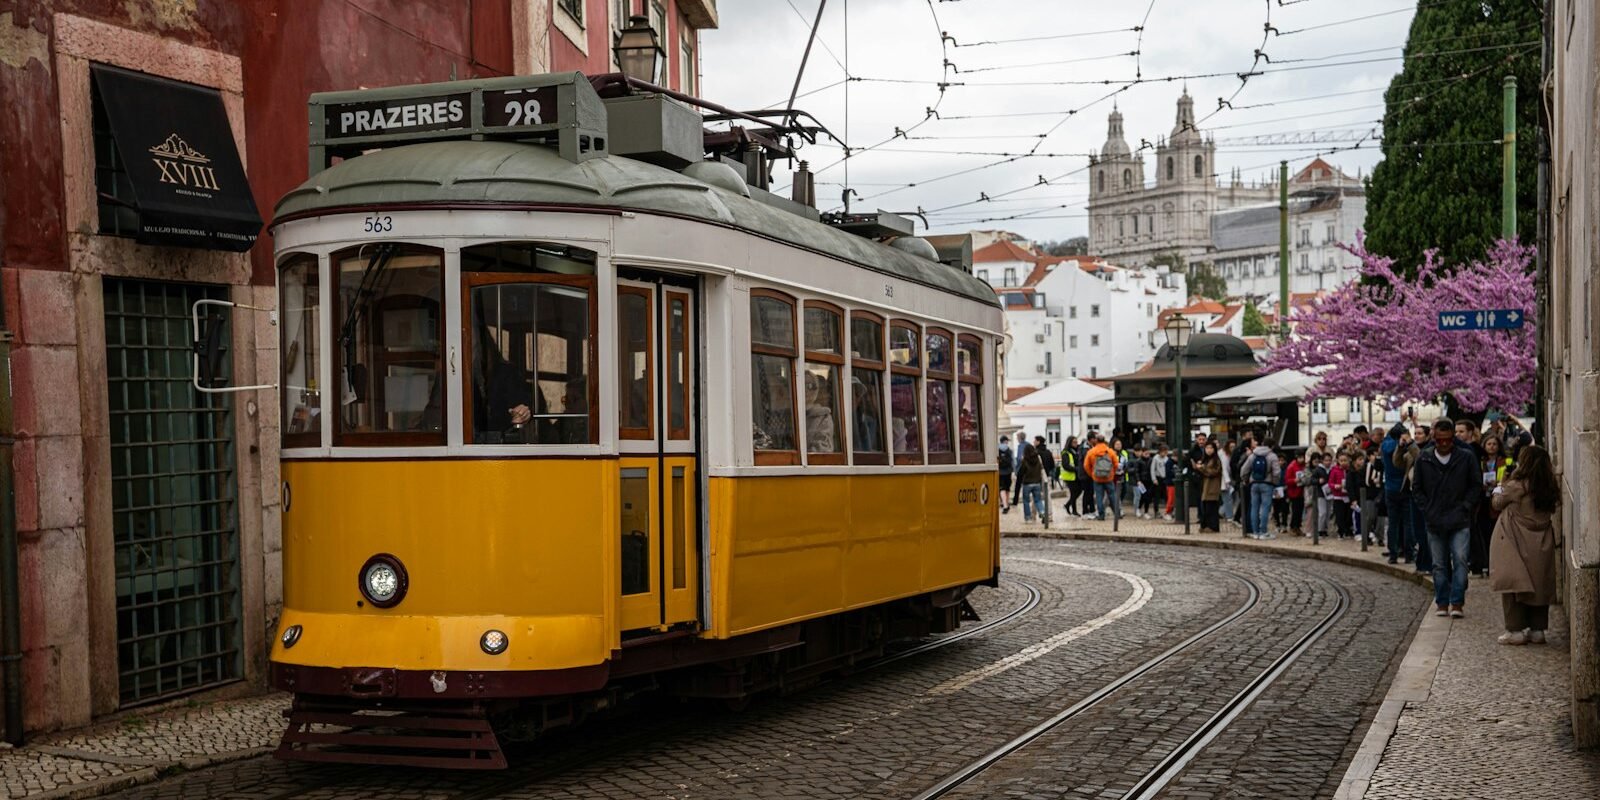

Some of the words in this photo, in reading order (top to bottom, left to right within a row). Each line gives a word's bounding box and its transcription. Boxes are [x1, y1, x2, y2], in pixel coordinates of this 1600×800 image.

[340, 100, 464, 134] PRAZERES
[505, 99, 542, 127] 28
[152, 158, 221, 191] XVIII
[171, 228, 206, 236] TRADICIONAL
[364, 215, 392, 233] 563
[885, 284, 894, 298] 563
[1442, 316, 1466, 326] WC
[958, 482, 977, 504] carris
